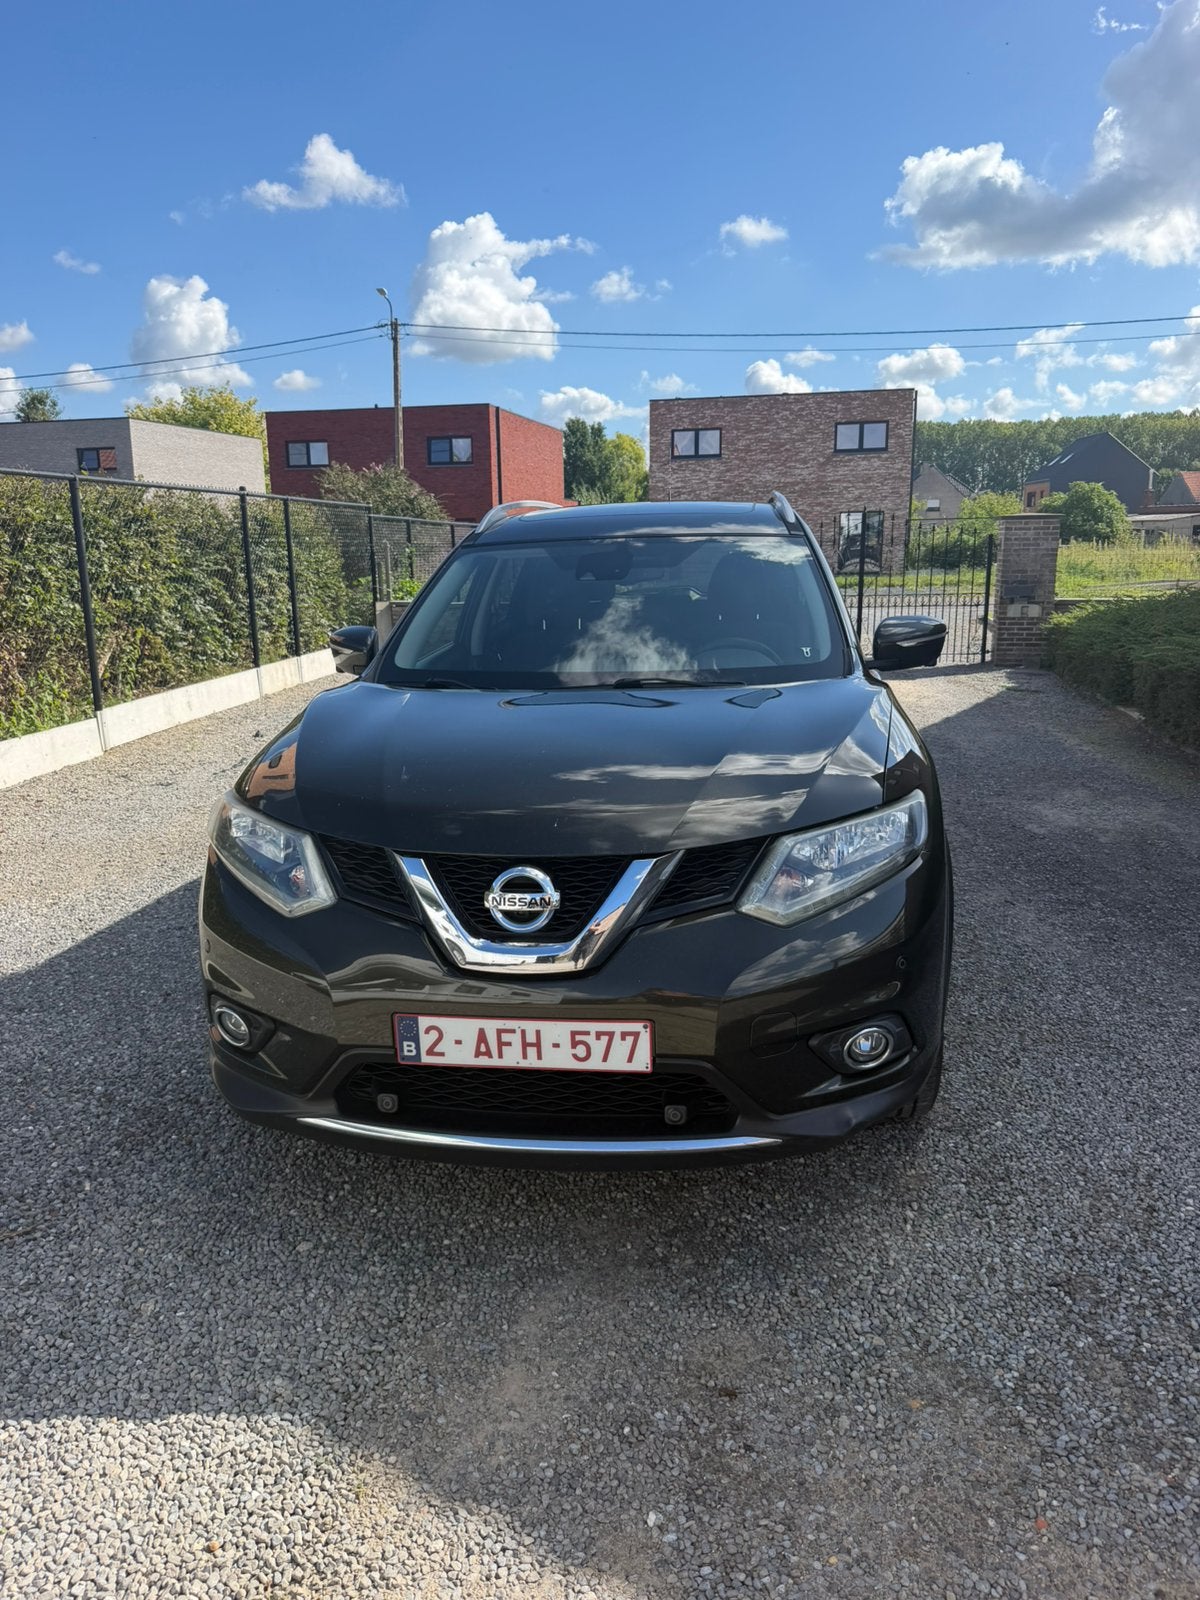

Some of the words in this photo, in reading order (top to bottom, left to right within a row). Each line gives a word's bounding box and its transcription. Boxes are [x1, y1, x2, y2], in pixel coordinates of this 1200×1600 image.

[491, 896, 551, 908] NISSAN
[402, 1040, 417, 1056] B
[423, 1025, 641, 1064] 2-AFH-577
